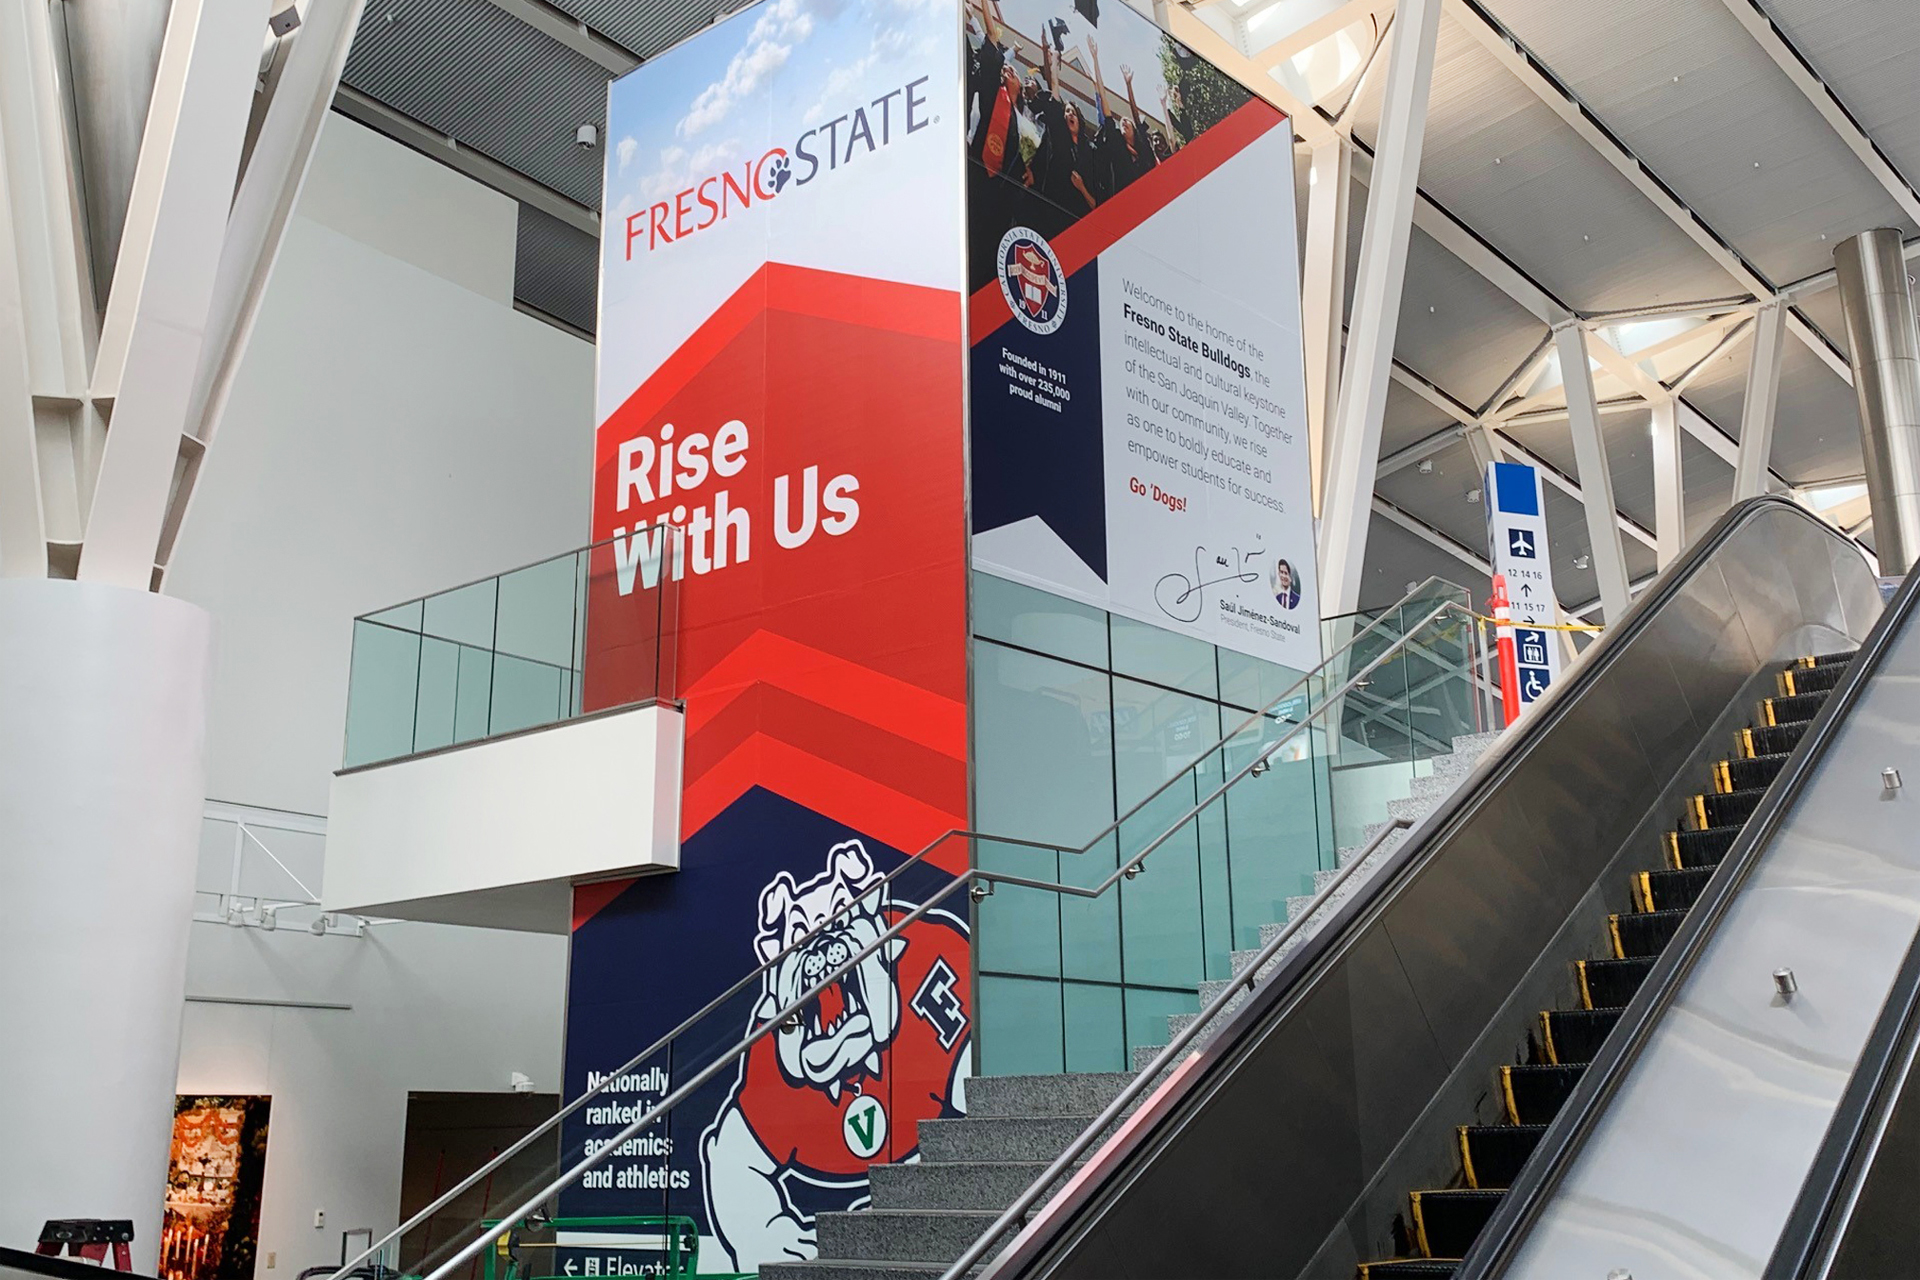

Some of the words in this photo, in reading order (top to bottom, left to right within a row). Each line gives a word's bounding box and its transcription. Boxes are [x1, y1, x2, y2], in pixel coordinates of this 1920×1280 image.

[626, 148, 789, 261] FRESNO
[1122, 278, 1172, 316] Welcome
[1175, 306, 1185, 322] to
[1187, 312, 1204, 332] the
[1205, 320, 1235, 348] home
[1236, 338, 1246, 352] of
[1248, 344, 1264, 362] the
[1123, 302, 1166, 337] Fresno
[1168, 326, 1199, 353] State
[1255, 370, 1270, 388] the
[999, 364, 1017, 379] with
[1018, 372, 1036, 387] over
[1038, 379, 1070, 401] 235,000
[1002, 347, 1037, 372] Founded
[1039, 363, 1046, 376] in
[1048, 368, 1066, 385] 1911
[1124, 330, 1181, 371] intellectual
[1183, 361, 1202, 380] and
[1205, 372, 1241, 398] cultural
[1244, 387, 1286, 418] keystone
[1009, 383, 1033, 401] proud
[1034, 393, 1062, 413] alumni
[1125, 360, 1136, 374] of
[1138, 364, 1155, 383] the
[1157, 372, 1178, 393] San
[1179, 383, 1219, 412] Joaquin
[1252, 415, 1293, 445] Together
[1126, 386, 1149, 406] with
[1151, 397, 1169, 415] our
[1171, 406, 1232, 445] community,
[1233, 434, 1248, 449] we
[1250, 440, 1268, 458] rise
[617, 420, 749, 512] Rise
[1126, 412, 1140, 428] as
[1142, 420, 1163, 438] one
[1165, 427, 1177, 444] to
[1178, 432, 1210, 461] boldly
[1211, 450, 1251, 476] educate
[1253, 467, 1272, 484] and
[1128, 440, 1179, 470] empower
[1181, 461, 1226, 490] students
[1227, 478, 1243, 496] for
[1129, 476, 1146, 496] Go
[613, 490, 750, 597] With
[774, 465, 860, 549] Us
[1508, 568, 1518, 577] 12
[1521, 570, 1531, 578] 14
[1533, 571, 1543, 580] 16
[1250, 623, 1270, 638] Fresno
[1511, 602, 1520, 610] 11
[1524, 603, 1534, 611] 15
[1536, 604, 1545, 612] 17
[910, 956, 969, 1052] F
[586, 1100, 642, 1125] ranked
[848, 1104, 877, 1151] V
[583, 1164, 613, 1189] and
[616, 1164, 690, 1189] athletics
